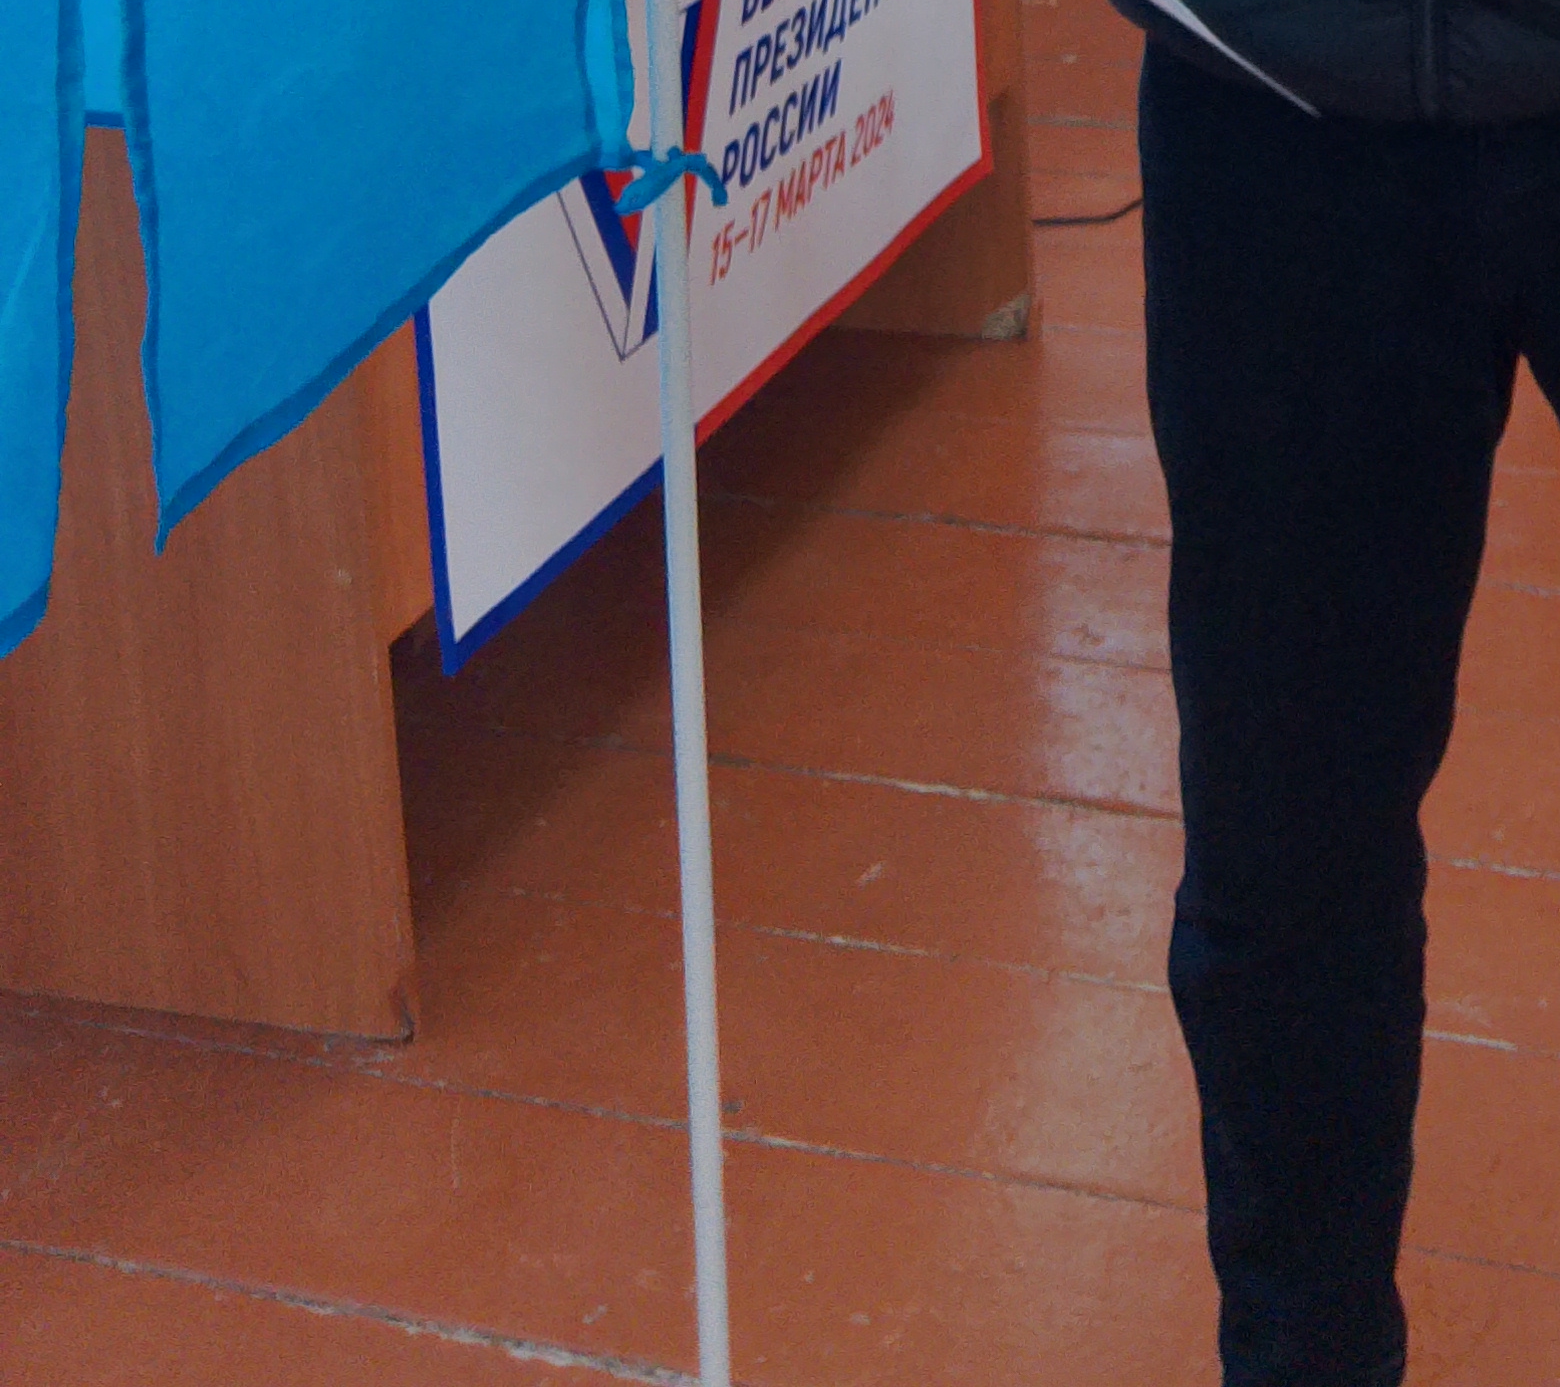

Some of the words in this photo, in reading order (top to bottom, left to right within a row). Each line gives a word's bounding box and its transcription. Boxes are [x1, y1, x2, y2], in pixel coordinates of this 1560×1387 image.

[722, 58, 843, 189] РОССИИ
[774, 129, 847, 233] МАРТА
[850, 88, 897, 169] 2024
